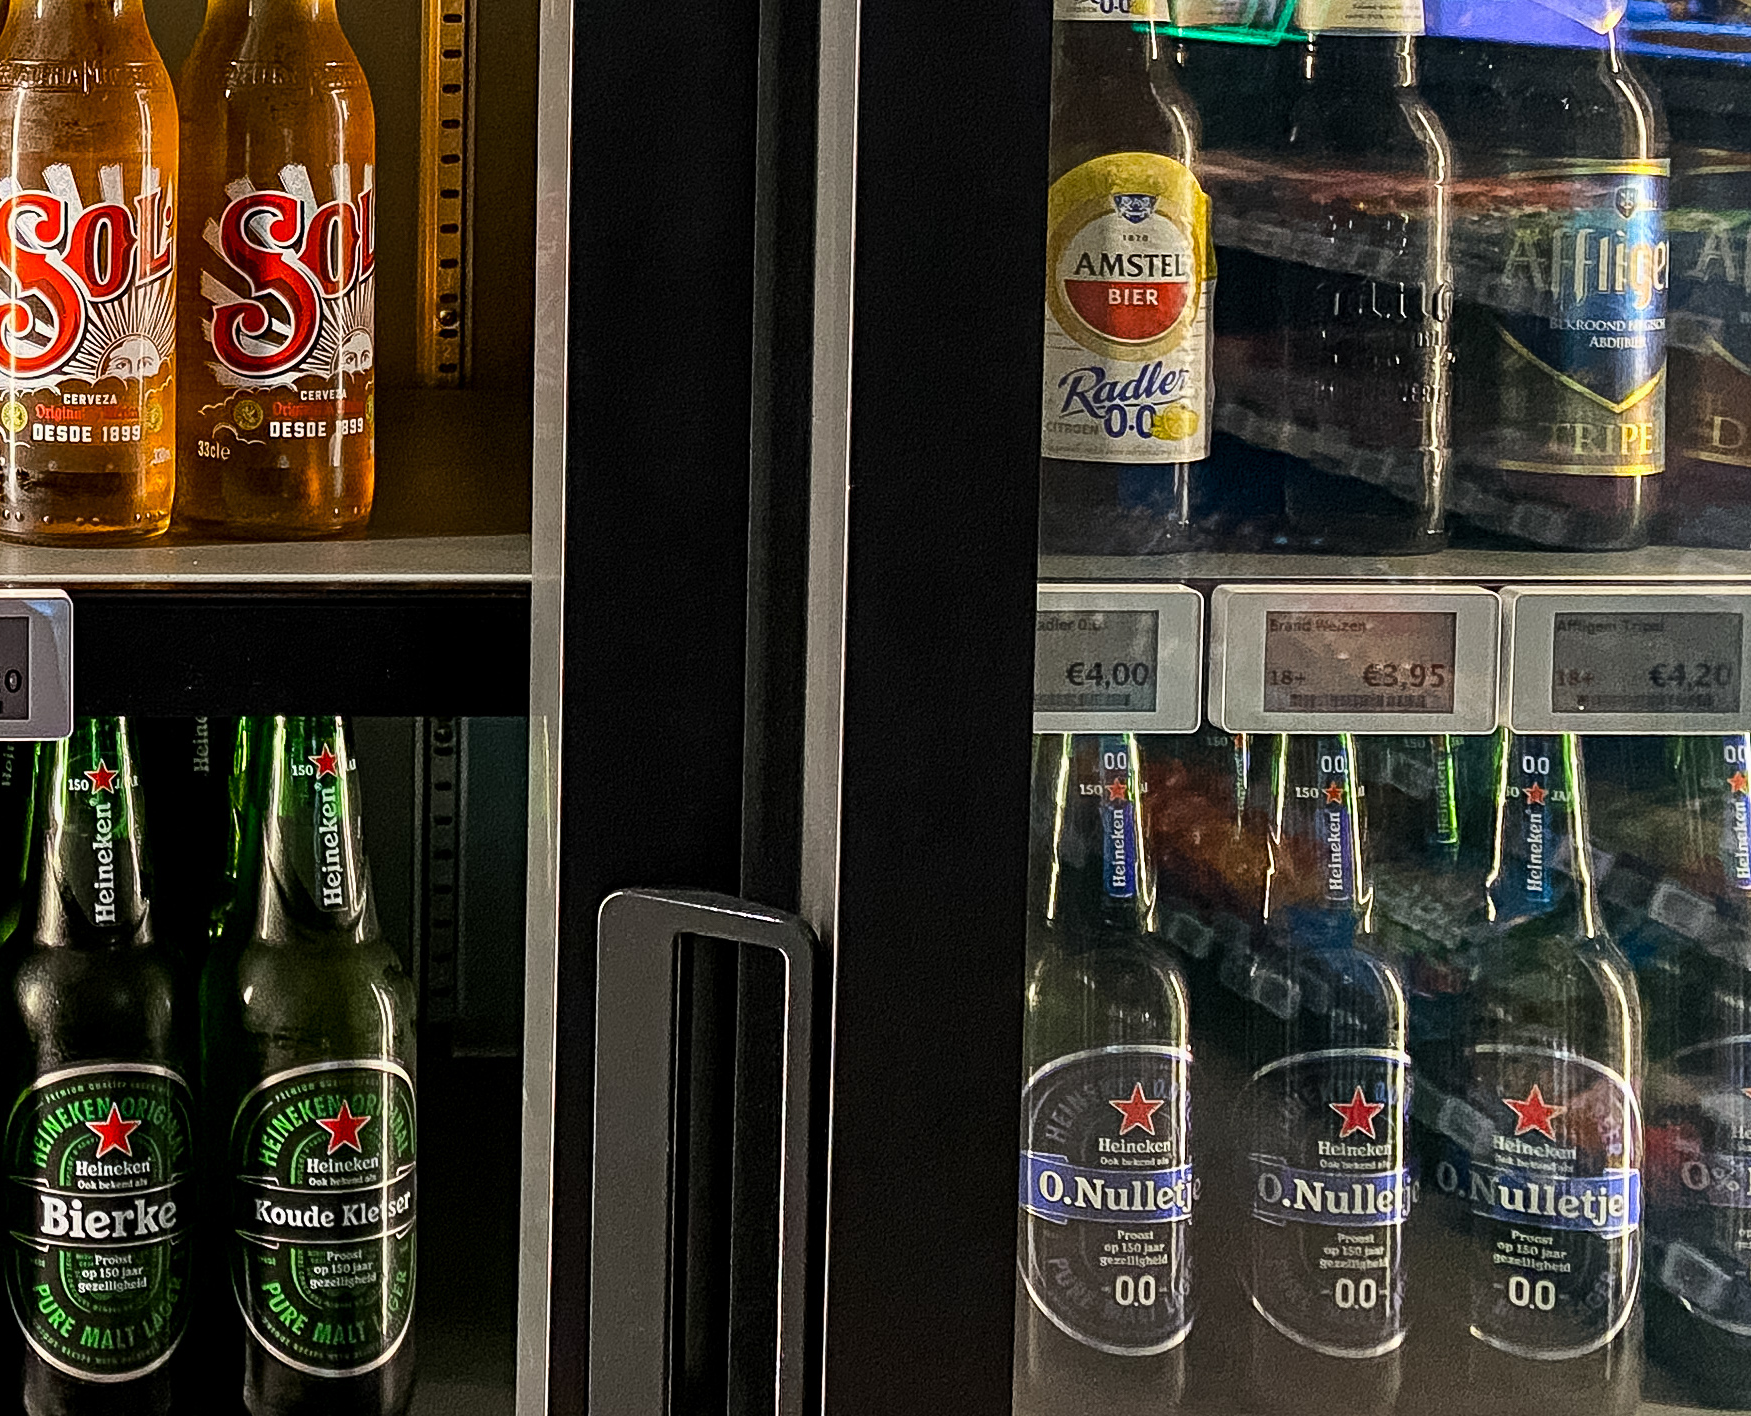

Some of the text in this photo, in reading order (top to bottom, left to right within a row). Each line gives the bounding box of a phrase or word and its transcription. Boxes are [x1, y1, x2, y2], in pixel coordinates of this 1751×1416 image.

[1074, 253, 1186, 277] AMSTEL
[1503, 228, 1670, 310] Afflige
[212, 189, 375, 379] SOL
[1108, 288, 1159, 307] BIER
[63, 394, 118, 406] CERVEZA
[301, 389, 347, 401] CERVEZA
[1058, 361, 1189, 420] Radler
[32, 425, 141, 444] DESDE 1899
[270, 417, 364, 438] DESDE 1899
[1551, 422, 1654, 456] TRIPE
[1037, 618, 1075, 631] adler
[1270, 620, 1311, 633] Brand
[1066, 662, 1148, 690] €4,00
[1270, 670, 1305, 685] 18+
[1363, 663, 1445, 691] €3,95
[1649, 663, 1733, 690] €4,20
[319, 786, 343, 907] Heineken
[1113, 809, 1127, 887] Heineken
[1328, 811, 1342, 891] Heineken
[1526, 813, 1543, 892] Heineken
[93, 802, 116, 926] Heineken
[259, 1094, 341, 1167] HEINEKEN
[1099, 1138, 1172, 1153] Heineken
[1318, 1140, 1392, 1157] Heineken
[75, 1159, 151, 1177] Heineken
[307, 1154, 380, 1174] Heineken
[40, 1195, 177, 1240] Bierke
[255, 1198, 335, 1228] Koude
[1115, 1275, 1156, 1307] 0.0
[1335, 1278, 1377, 1309] 0.0
[1509, 1276, 1555, 1310] 0.0
[34, 1283, 75, 1339] PURE
[263, 1282, 308, 1335] PURE
